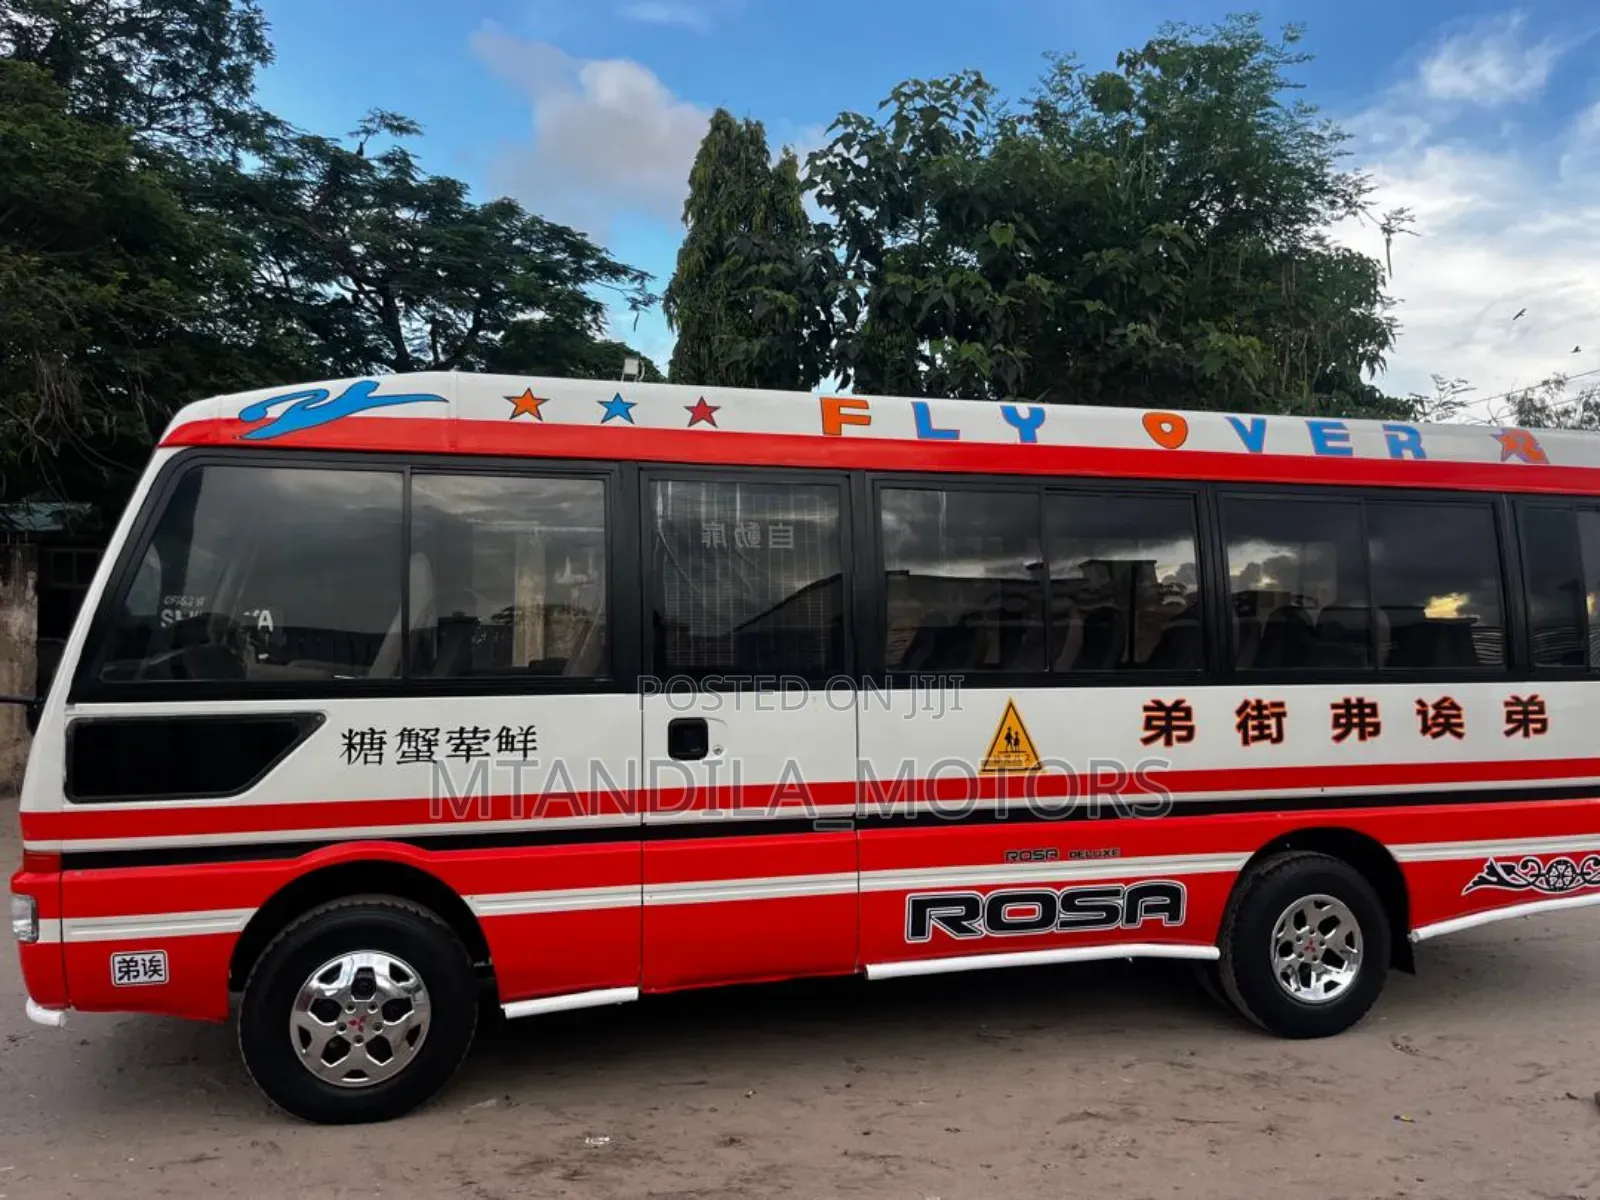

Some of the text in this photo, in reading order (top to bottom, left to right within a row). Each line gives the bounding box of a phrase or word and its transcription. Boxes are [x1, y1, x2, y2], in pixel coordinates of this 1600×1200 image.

[819, 396, 1427, 460] FLY OVER
[1004, 847, 1122, 863] ROSA DELUXE
[904, 879, 1188, 944] ROSA
